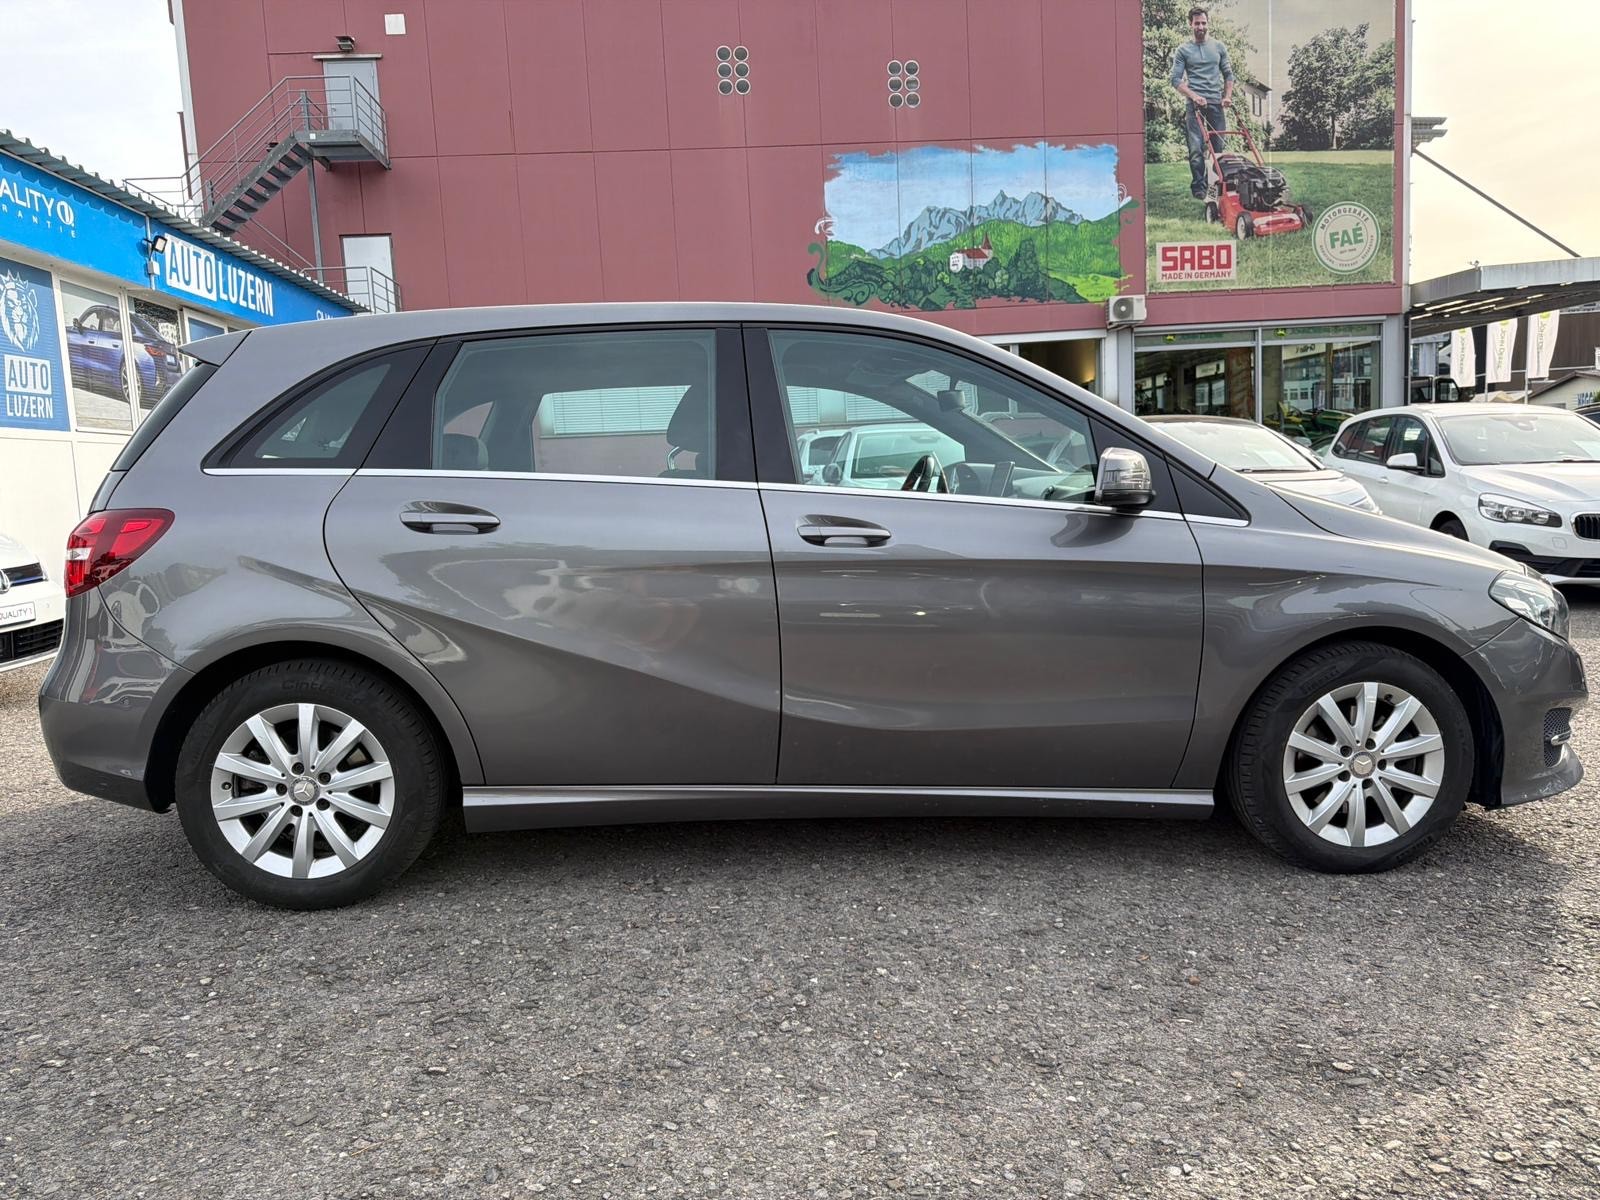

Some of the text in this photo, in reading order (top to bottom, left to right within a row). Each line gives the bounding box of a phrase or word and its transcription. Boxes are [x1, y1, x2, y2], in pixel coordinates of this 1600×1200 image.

[1329, 221, 1365, 250] FAÉ
[1161, 244, 1232, 272] SABO
[169, 240, 274, 317] AUTO LUZERN
[1161, 272, 1184, 280] MADE
[1194, 271, 1232, 279] GERMANY
[8, 359, 49, 391] AUTO
[6, 393, 54, 419] LUZERN
